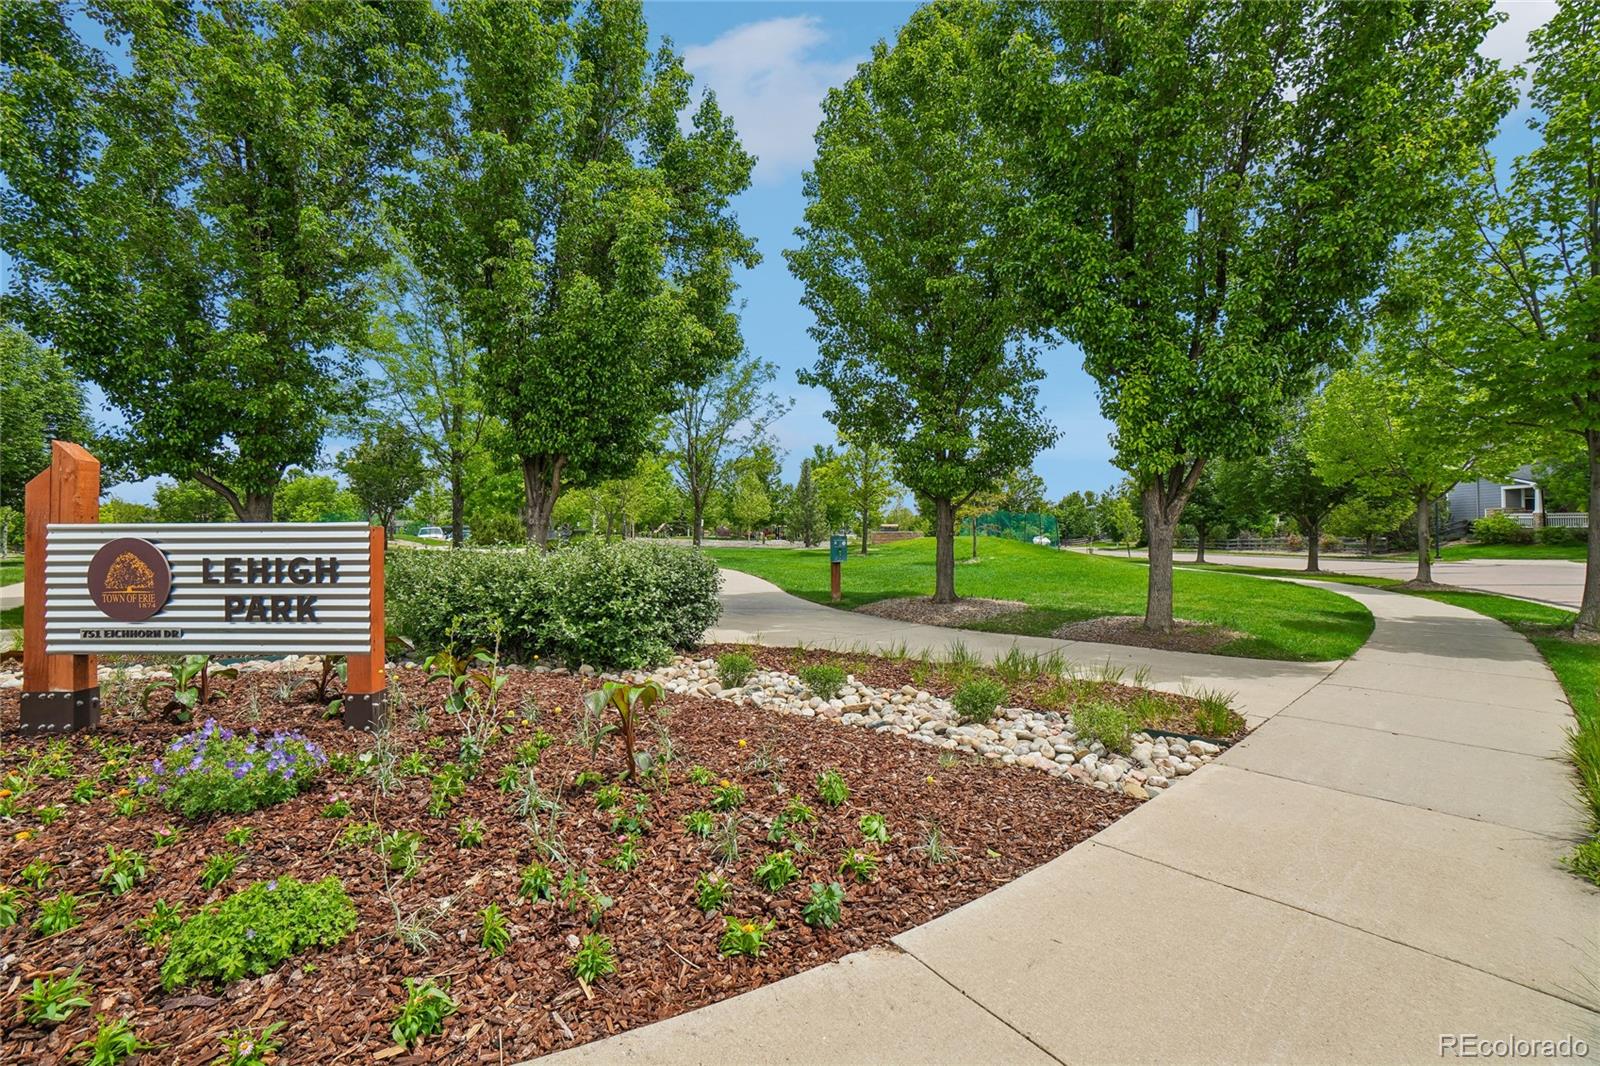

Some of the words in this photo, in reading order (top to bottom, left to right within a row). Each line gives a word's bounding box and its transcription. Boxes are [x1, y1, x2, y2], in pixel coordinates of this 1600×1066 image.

[202, 557, 338, 584] LEHIGH
[103, 594, 125, 603] TOWN
[126, 594, 137, 603] OF
[139, 594, 155, 603] ERIE
[224, 595, 318, 622] PARK
[82, 630, 101, 638] 751
[104, 630, 161, 638] EICHHORN
[164, 630, 179, 638] DR
